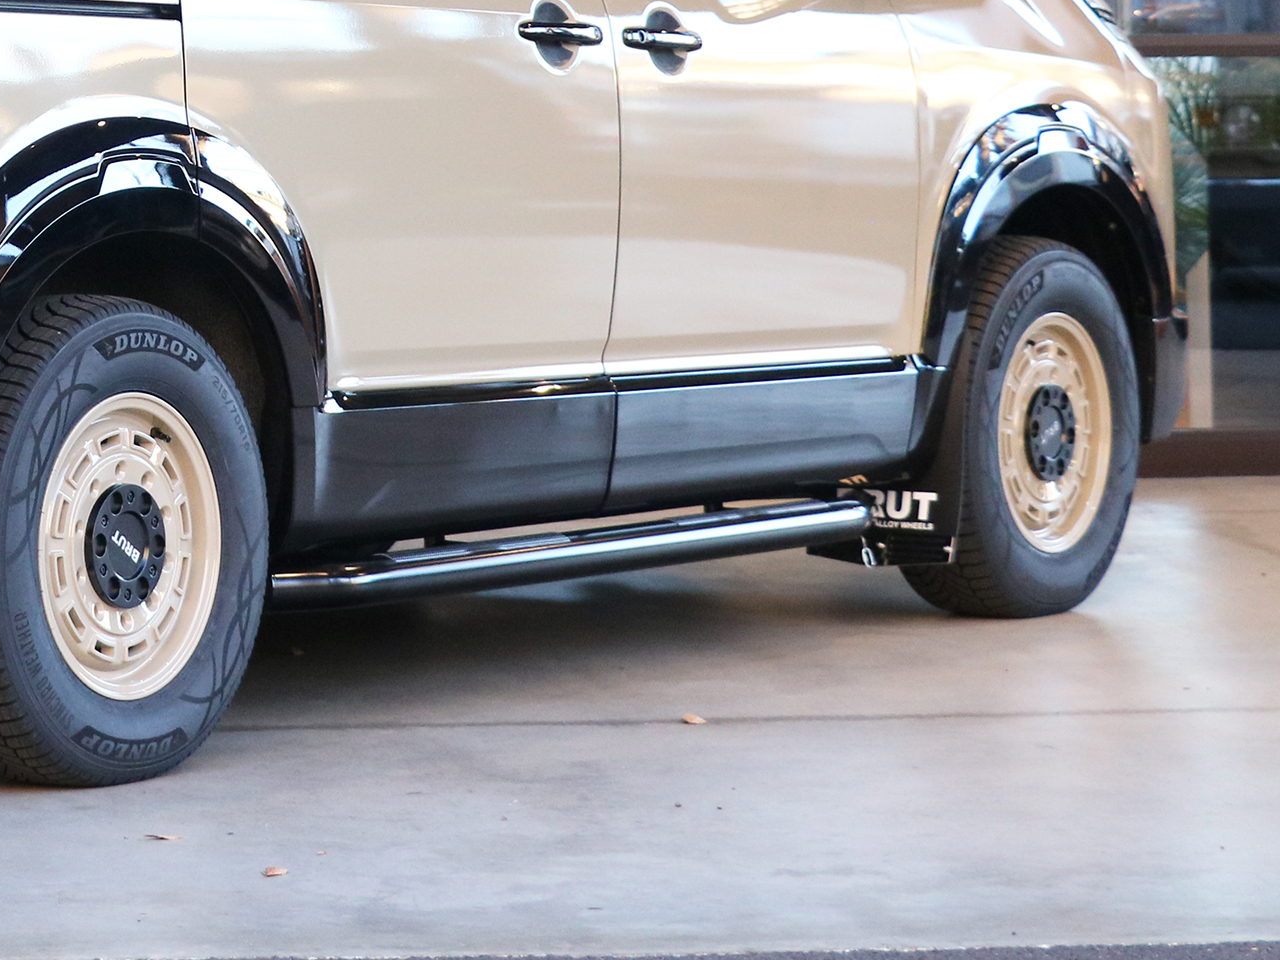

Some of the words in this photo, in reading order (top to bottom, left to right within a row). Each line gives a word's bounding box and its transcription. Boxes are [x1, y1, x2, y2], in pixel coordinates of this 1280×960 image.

[113, 332, 198, 364] DUNLOP
[837, 488, 938, 520] RUT
[111, 530, 141, 564] BRUT
[14, 610, 43, 678] WEATHER
[80, 734, 171, 760] DUNLOP
